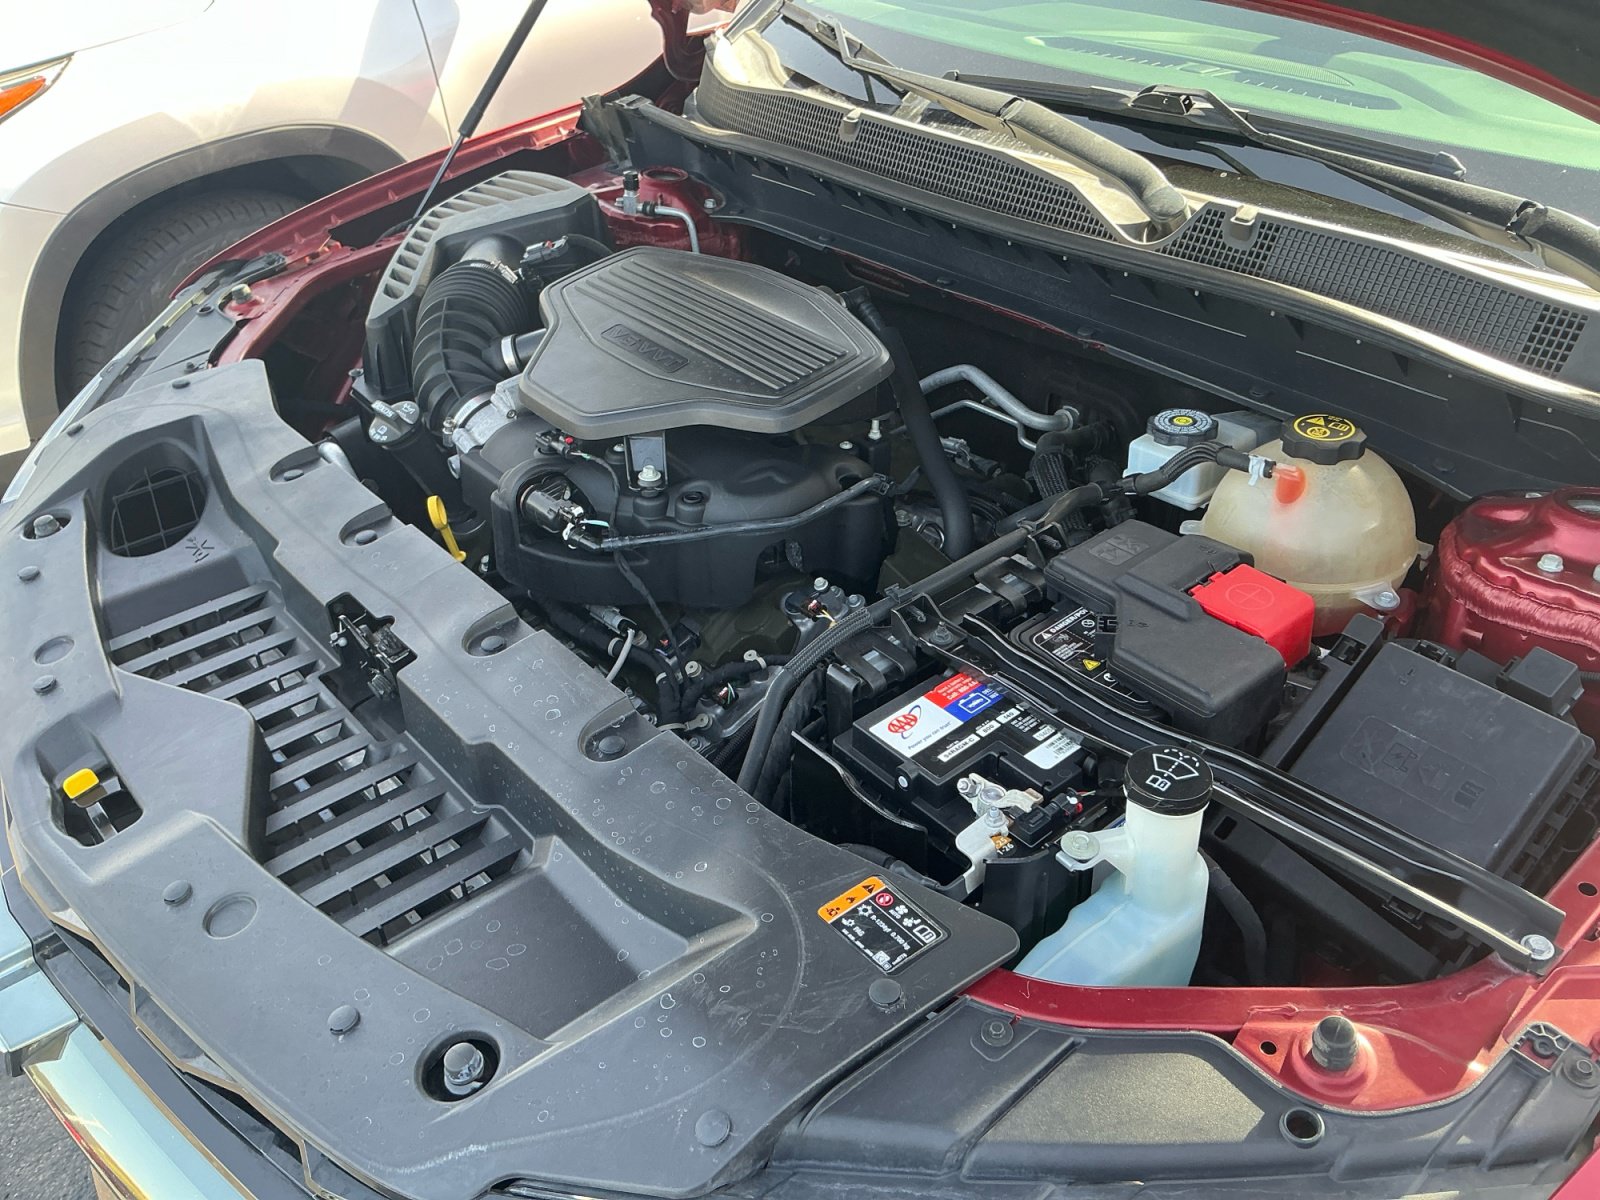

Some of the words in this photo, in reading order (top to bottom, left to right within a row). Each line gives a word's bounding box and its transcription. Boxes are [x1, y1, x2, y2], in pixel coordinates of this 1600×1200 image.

[888, 713, 918, 734] AAA
[923, 734, 932, 742] you
[997, 842, 1015, 855] 1-26
